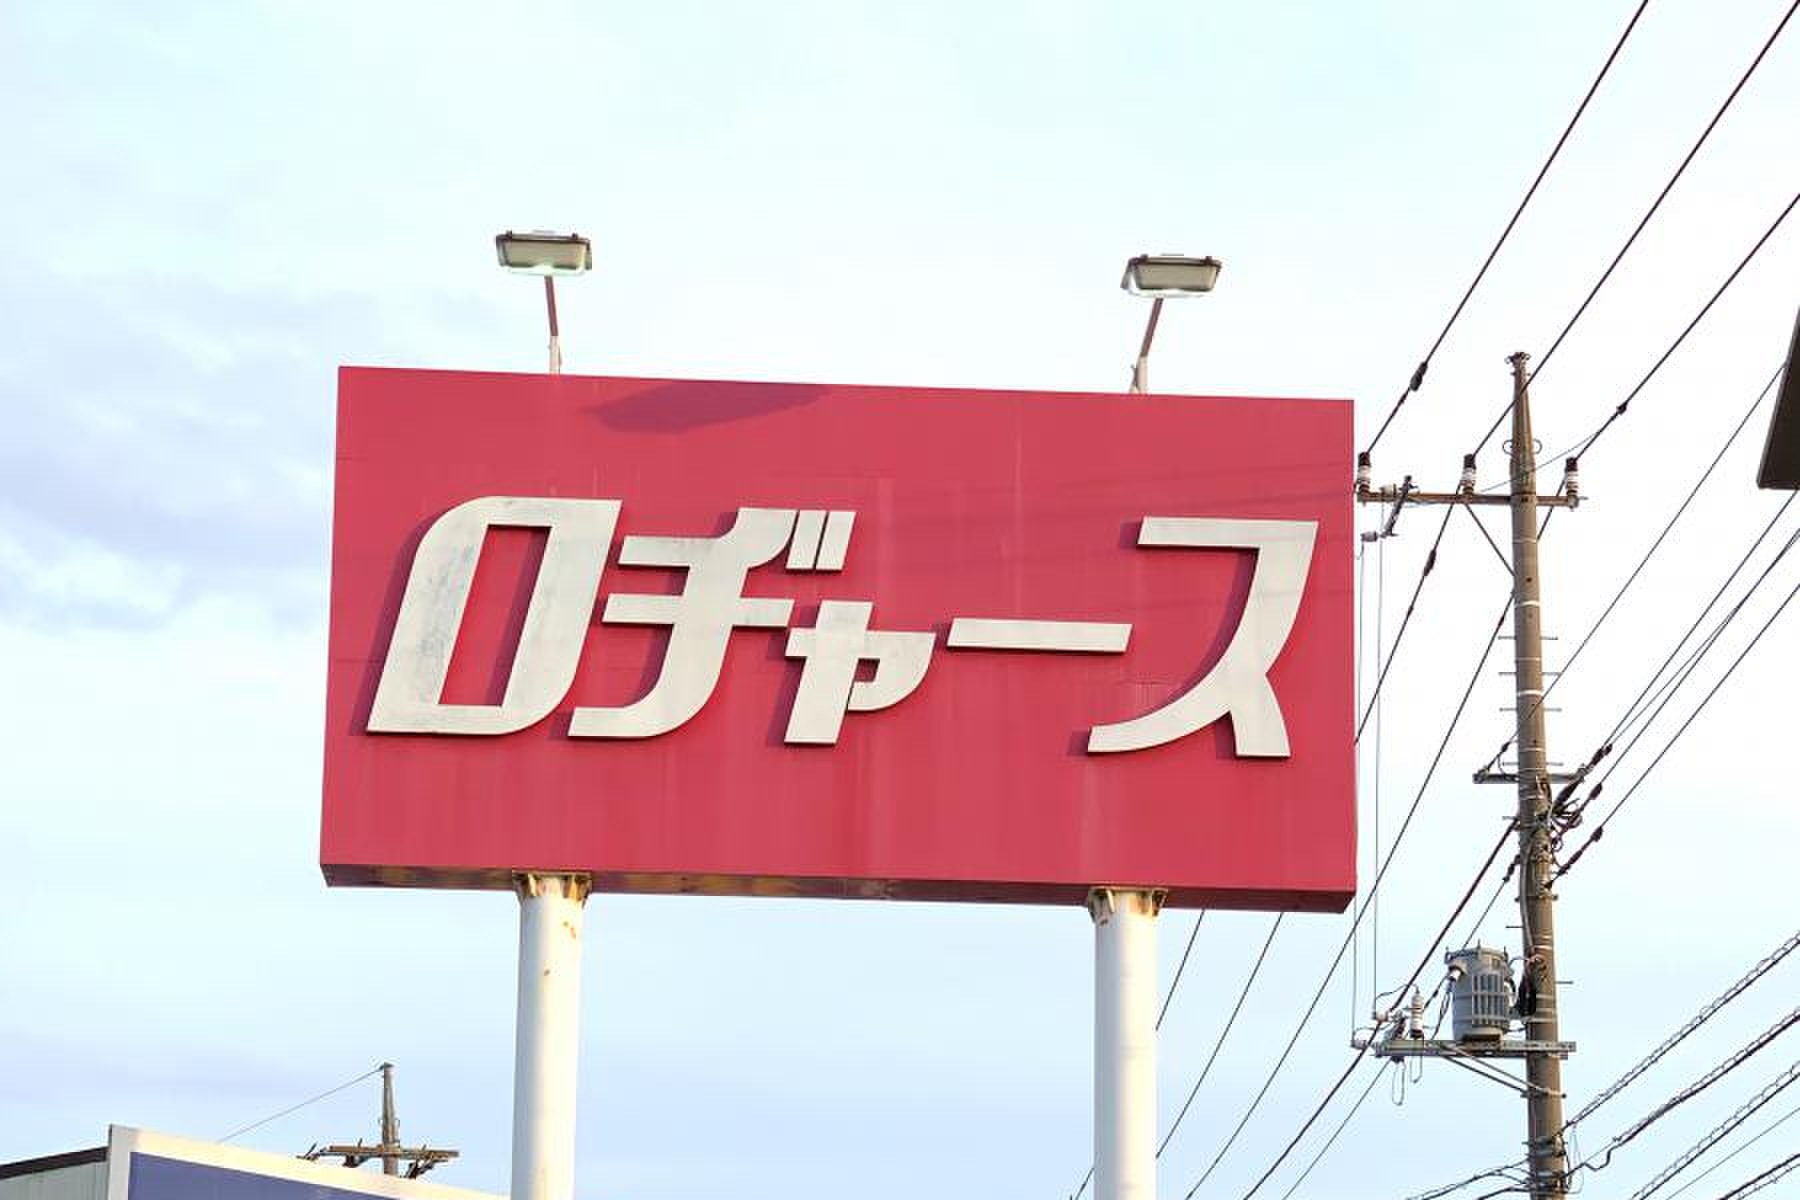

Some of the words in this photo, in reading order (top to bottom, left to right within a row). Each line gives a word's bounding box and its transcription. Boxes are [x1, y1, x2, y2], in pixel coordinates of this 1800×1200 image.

[366, 495, 1319, 757] ロヂャース
